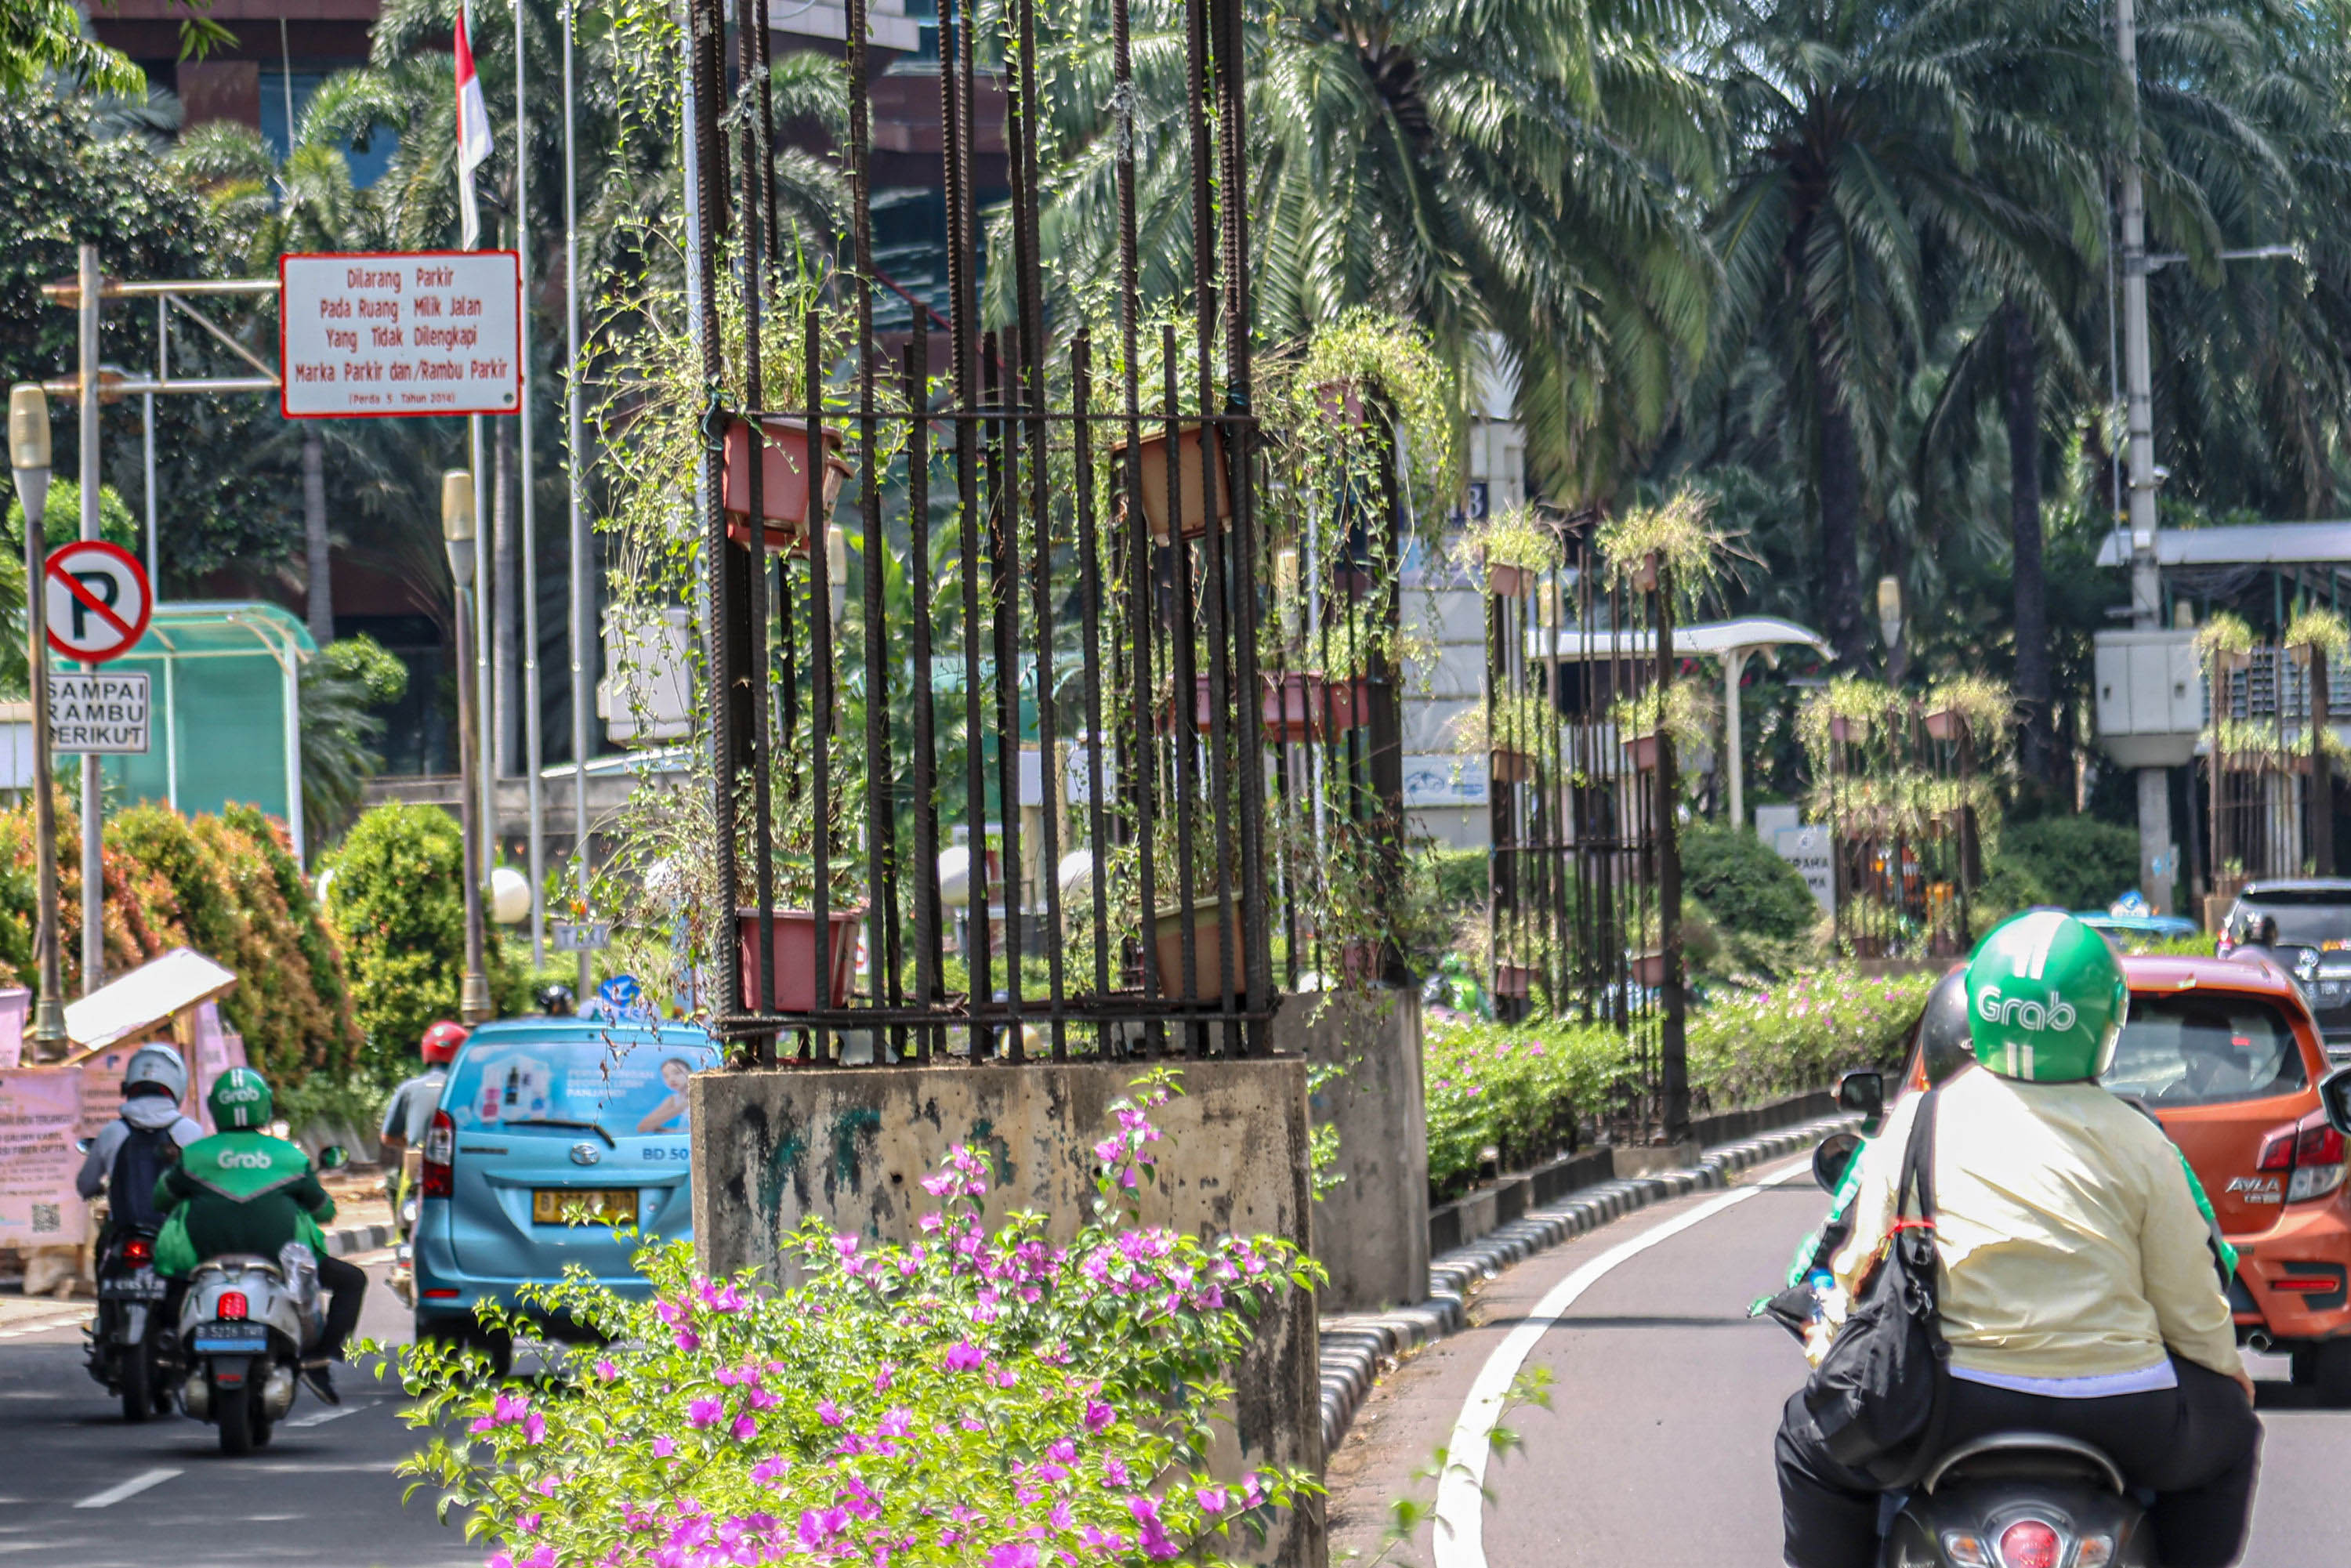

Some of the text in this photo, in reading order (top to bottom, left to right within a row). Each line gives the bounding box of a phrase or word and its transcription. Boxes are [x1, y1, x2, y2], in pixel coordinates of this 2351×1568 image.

[347, 266, 455, 293] Dilarang Parkir
[321, 296, 481, 322] Pada Ruang Milik Jalan
[326, 325, 478, 353] Yang Tidak Dilengkapi
[295, 363, 335, 382] Marka
[344, 361, 382, 382] Parkir
[470, 359, 508, 380] Parkir
[401, 393, 426, 404] Tahun
[1978, 985, 2077, 1032] Grab
[219, 1087, 259, 1104] Grab
[218, 1150, 272, 1168] Grab
[643, 1148, 665, 1160] BD
[2225, 1177, 2280, 1193] AYLA
[541, 1193, 550, 1211] B
